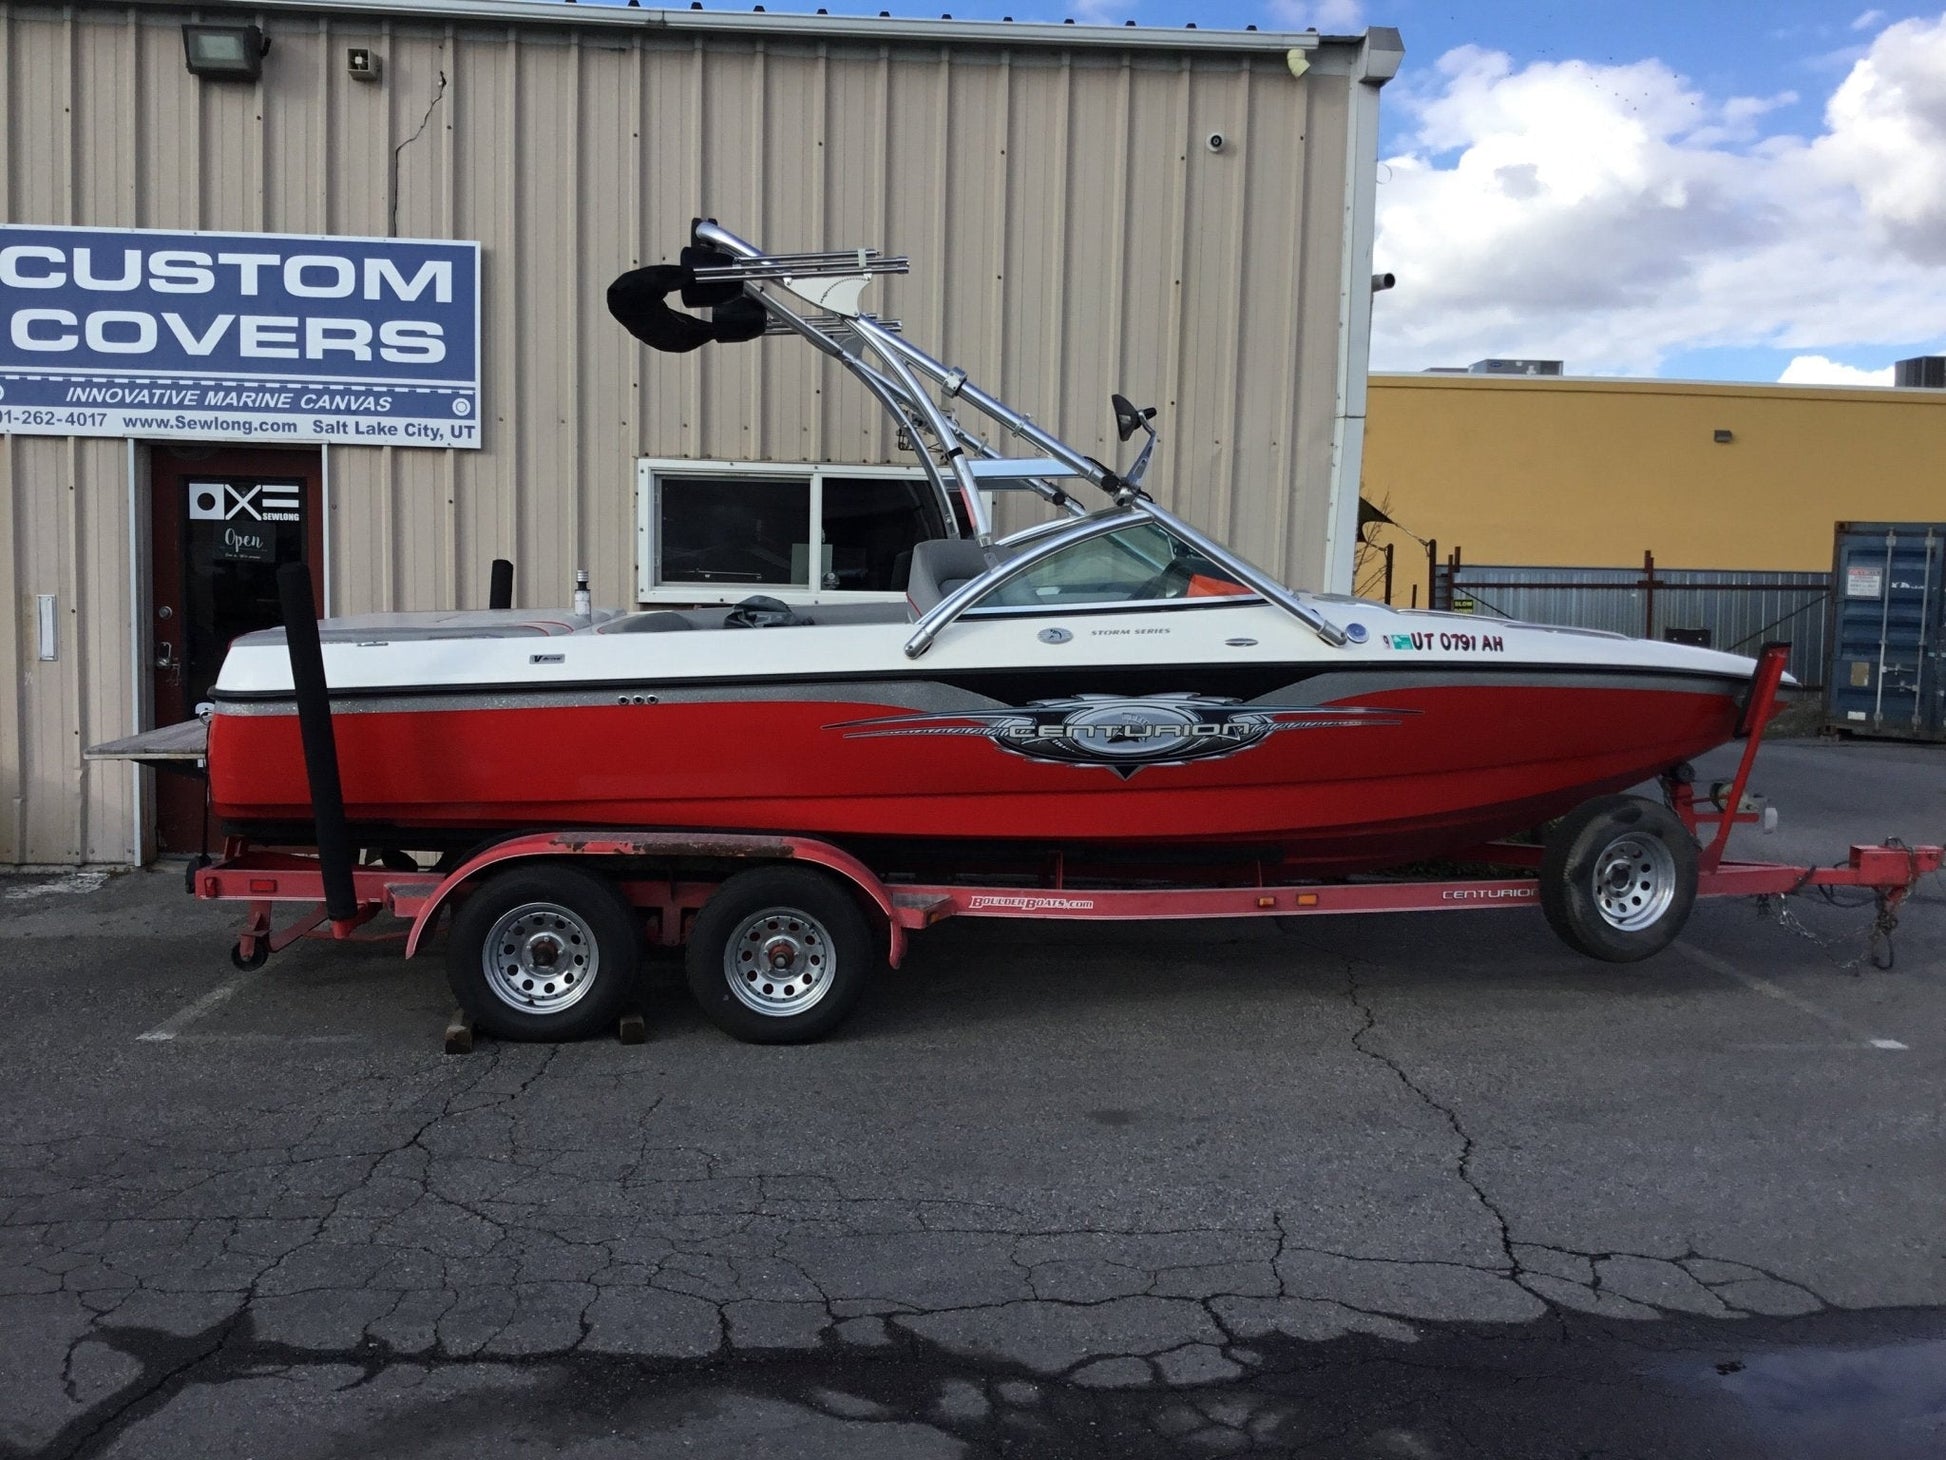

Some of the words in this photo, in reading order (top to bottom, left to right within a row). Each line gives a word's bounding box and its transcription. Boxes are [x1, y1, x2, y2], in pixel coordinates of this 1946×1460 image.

[0, 245, 453, 303] CUSTOM
[10, 308, 447, 364] COVERS
[65, 387, 201, 406] INNOVATIVE
[204, 391, 294, 409] MARINE
[300, 394, 392, 412] CANVAS
[0, 409, 107, 428] 1-262-4017
[122, 414, 298, 435] www.Sewlong.com
[312, 419, 349, 436] Salt
[354, 421, 398, 437] Lake
[404, 423, 444, 442] City,
[450, 425, 476, 440] UT
[224, 527, 264, 553] Open
[1411, 631, 1434, 651] UT
[1440, 632, 1476, 651] 0791
[1482, 634, 1504, 652] AH
[1009, 722, 1251, 738] CENTURION
